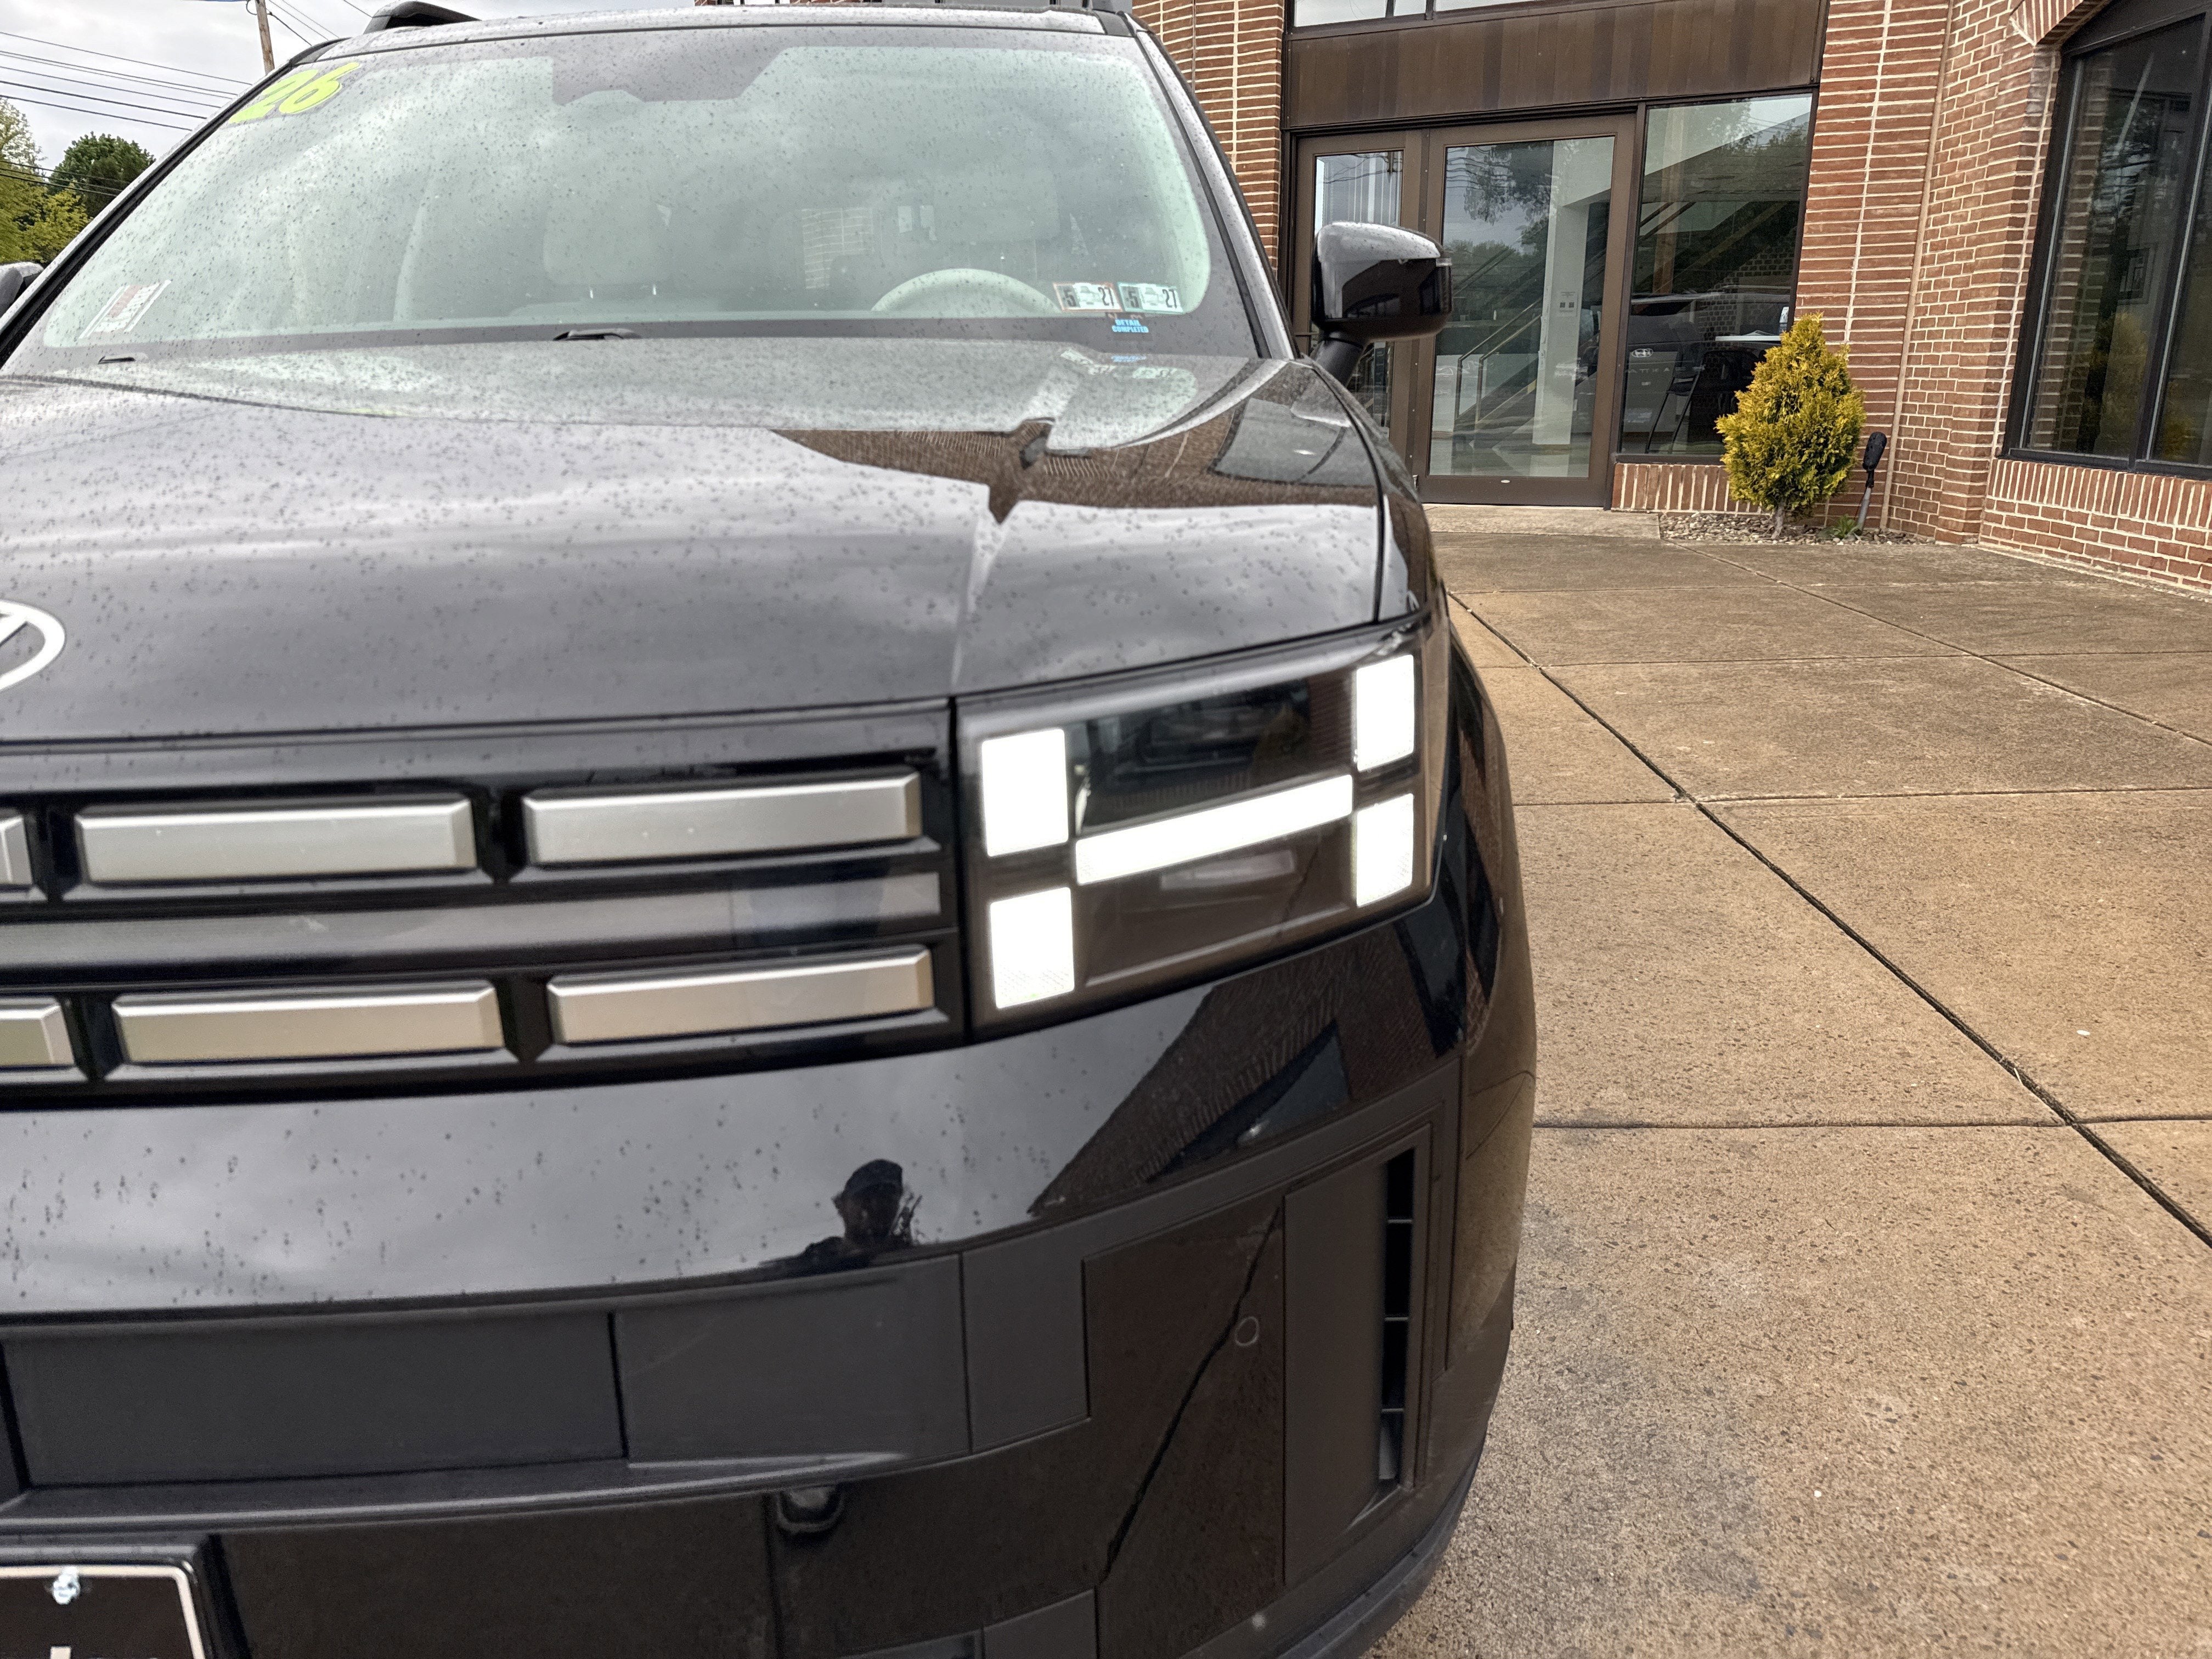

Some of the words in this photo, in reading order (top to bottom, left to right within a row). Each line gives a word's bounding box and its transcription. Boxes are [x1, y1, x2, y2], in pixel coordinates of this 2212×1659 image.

[228, 61, 362, 124] 26
[1097, 286, 1115, 307] 27
[1161, 289, 1177, 308] 27
